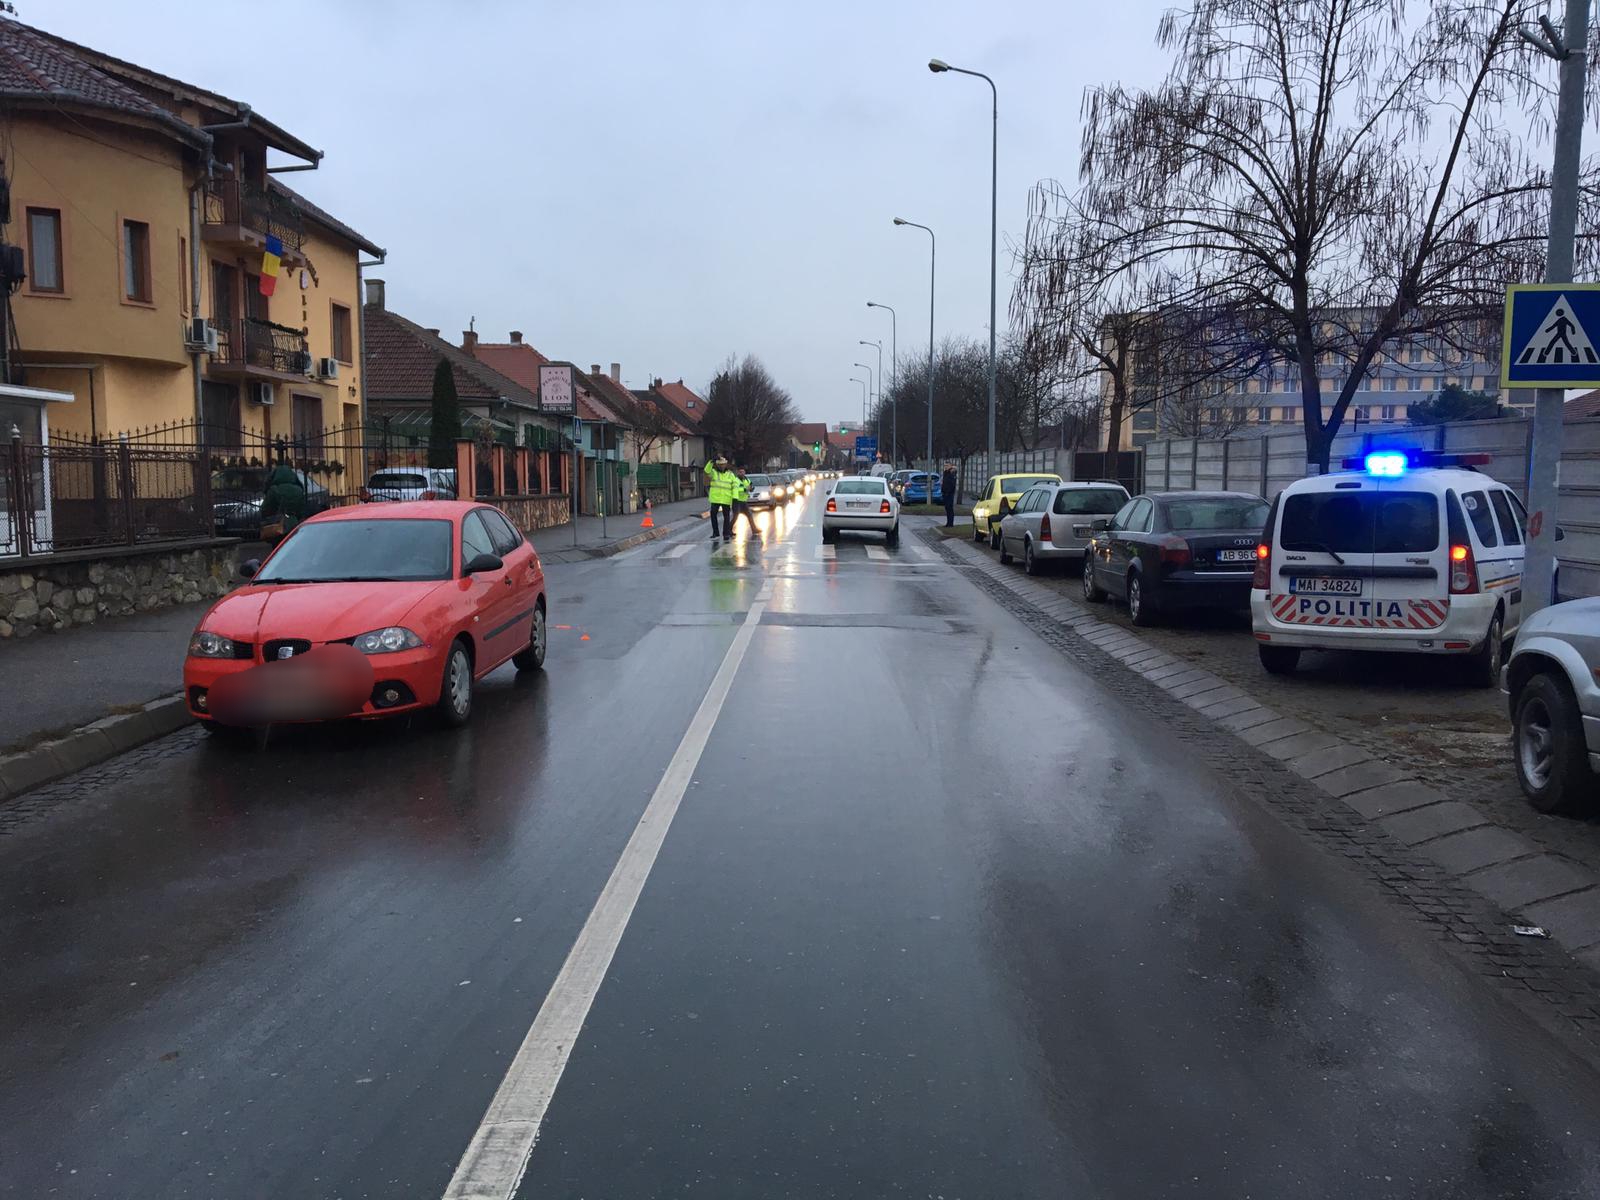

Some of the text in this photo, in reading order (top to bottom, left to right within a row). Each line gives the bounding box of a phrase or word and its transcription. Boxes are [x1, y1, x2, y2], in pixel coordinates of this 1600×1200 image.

[1223, 551, 1235, 559] AB
[1238, 551, 1249, 559] 96
[1298, 580, 1358, 592] MAI 34824
[1300, 599, 1403, 617] POLITIA
